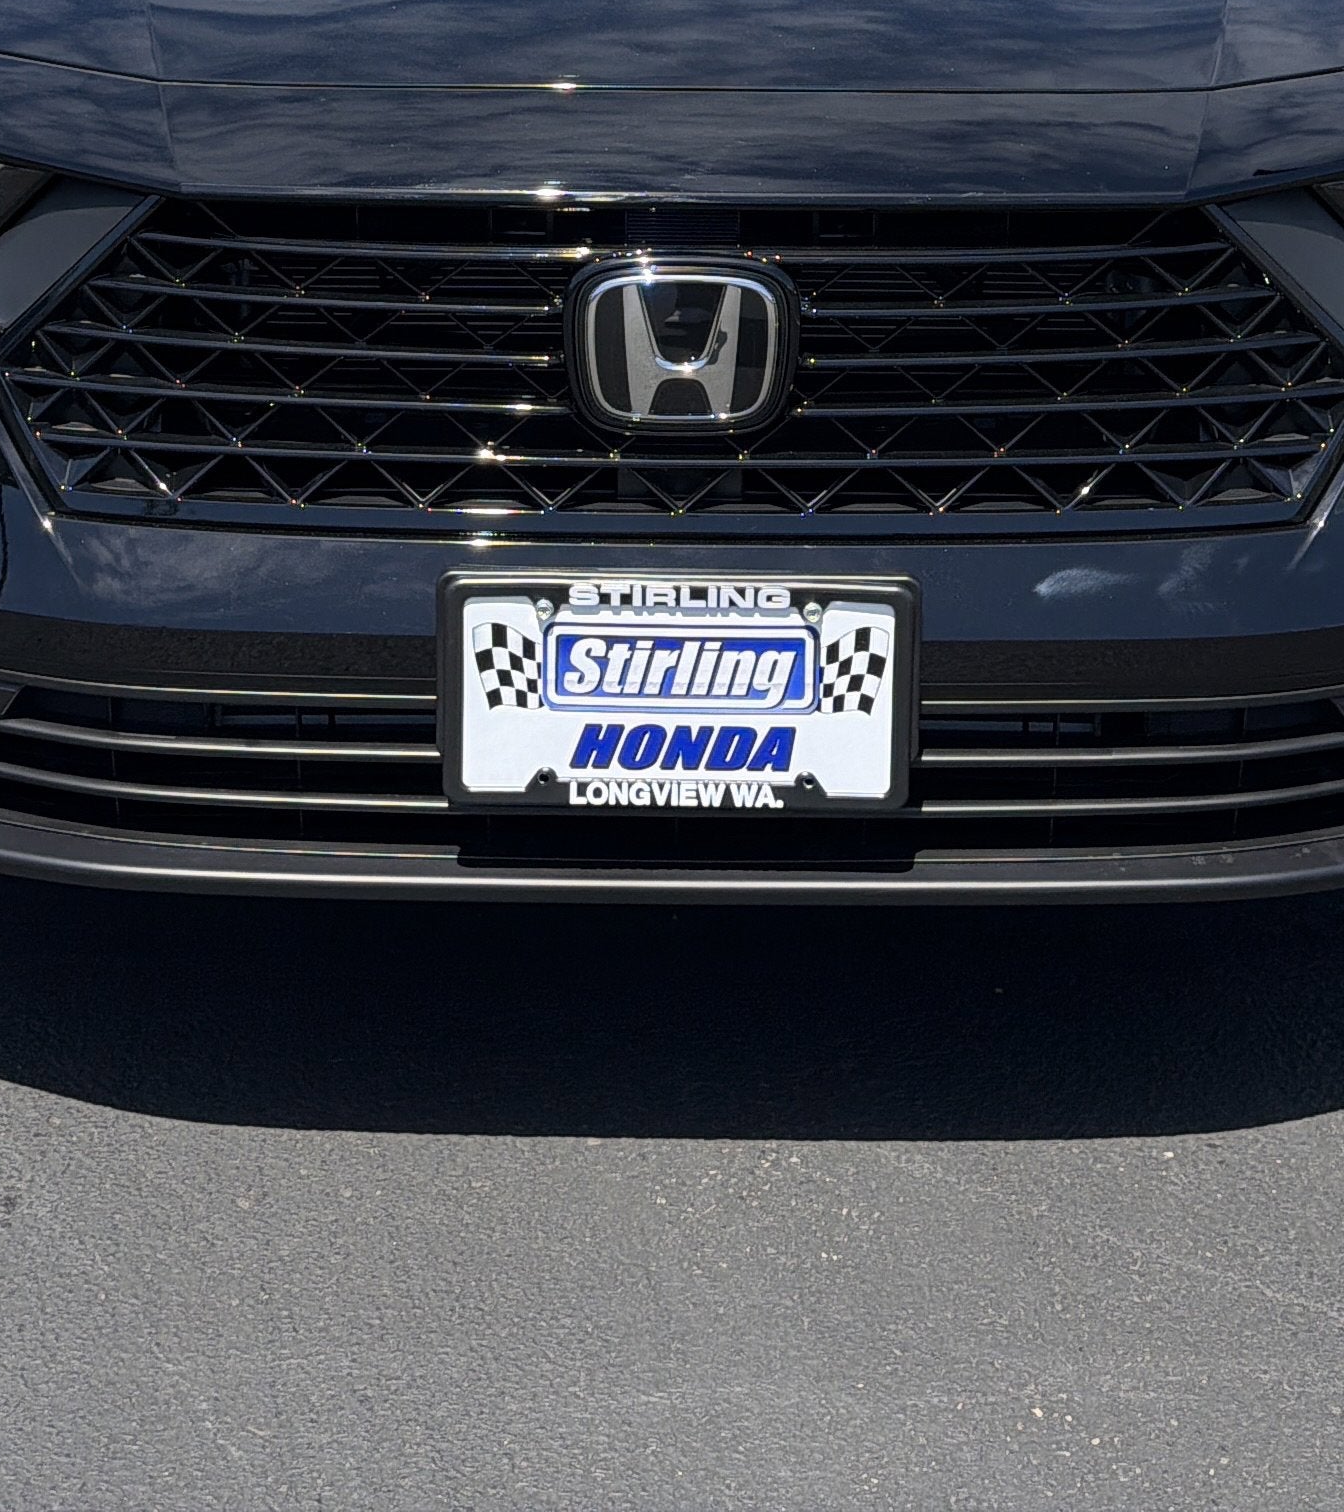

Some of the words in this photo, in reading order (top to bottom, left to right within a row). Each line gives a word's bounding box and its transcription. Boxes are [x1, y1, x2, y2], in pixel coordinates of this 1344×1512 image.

[568, 582, 792, 610] STIRLING
[563, 637, 797, 709] Stirling
[568, 722, 797, 773] HONDA
[568, 781, 729, 808] LONGVIEW
[730, 782, 785, 809] WA.
